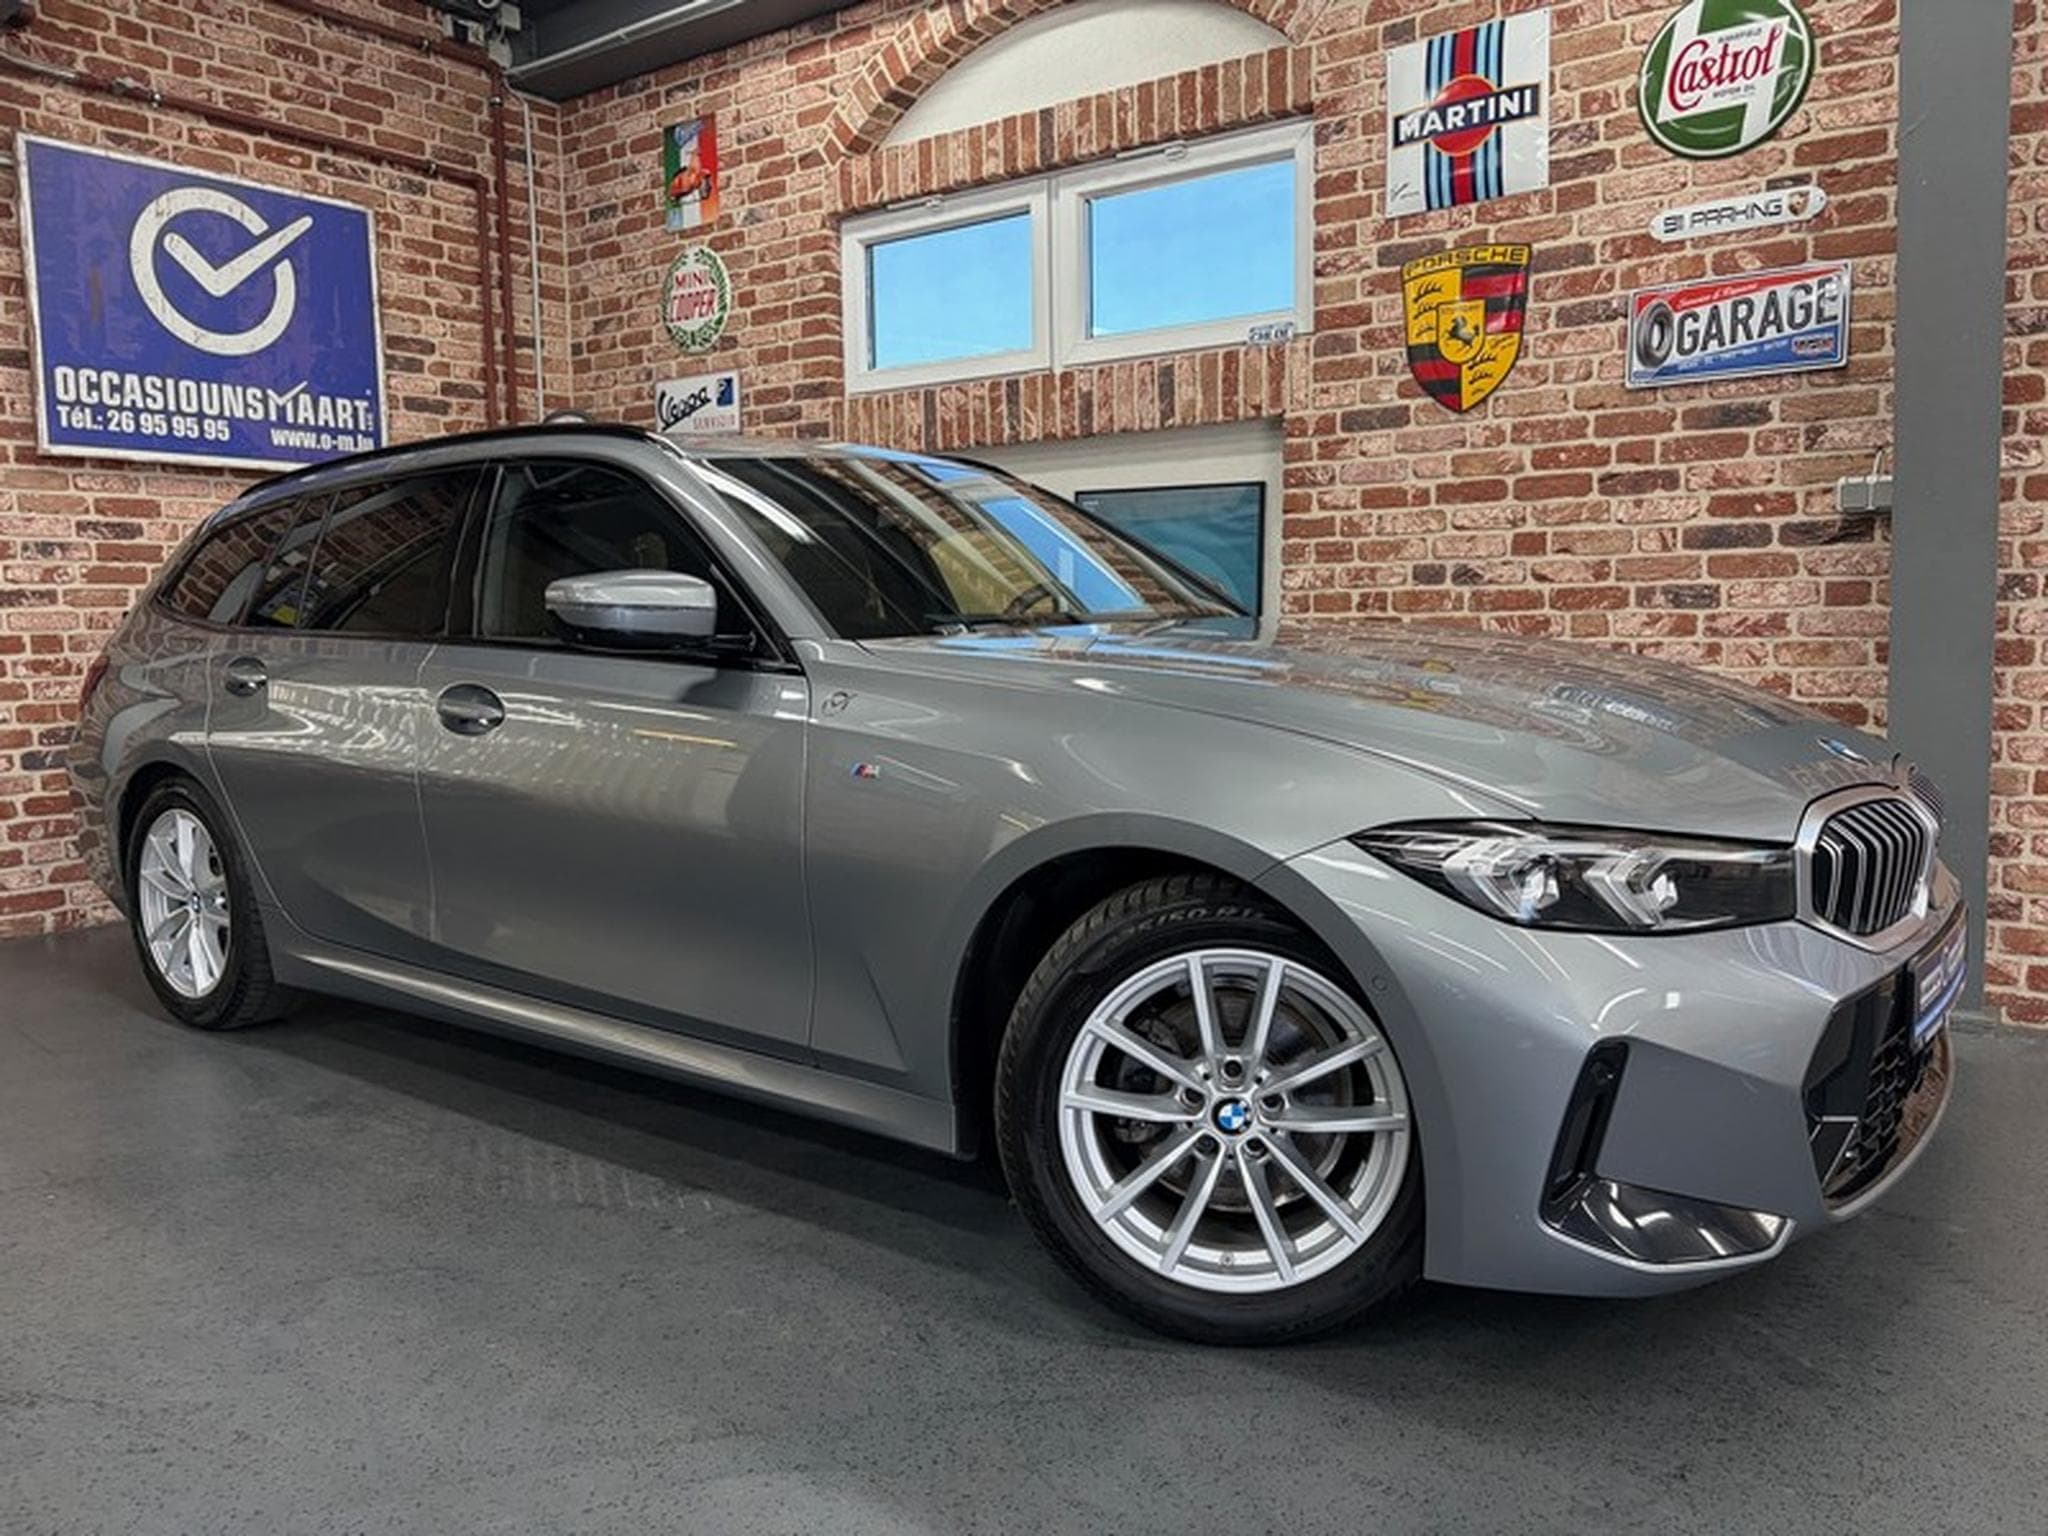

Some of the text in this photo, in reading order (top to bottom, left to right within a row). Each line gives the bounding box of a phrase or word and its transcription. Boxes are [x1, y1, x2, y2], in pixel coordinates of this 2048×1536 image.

[1668, 24, 1782, 112] Castrol
[1400, 88, 1532, 142] MARTINI
[1690, 199, 1783, 228] PARKING
[674, 269, 713, 290] MINI
[1405, 247, 1526, 277] PORSCHE
[1676, 273, 1841, 357] GARAGE
[54, 366, 369, 431] OCCASIOUNSMAART
[657, 387, 712, 431] Vespa
[107, 408, 136, 434] 26
[140, 412, 169, 437] 95
[172, 415, 200, 440] 95
[203, 418, 231, 442] 95
